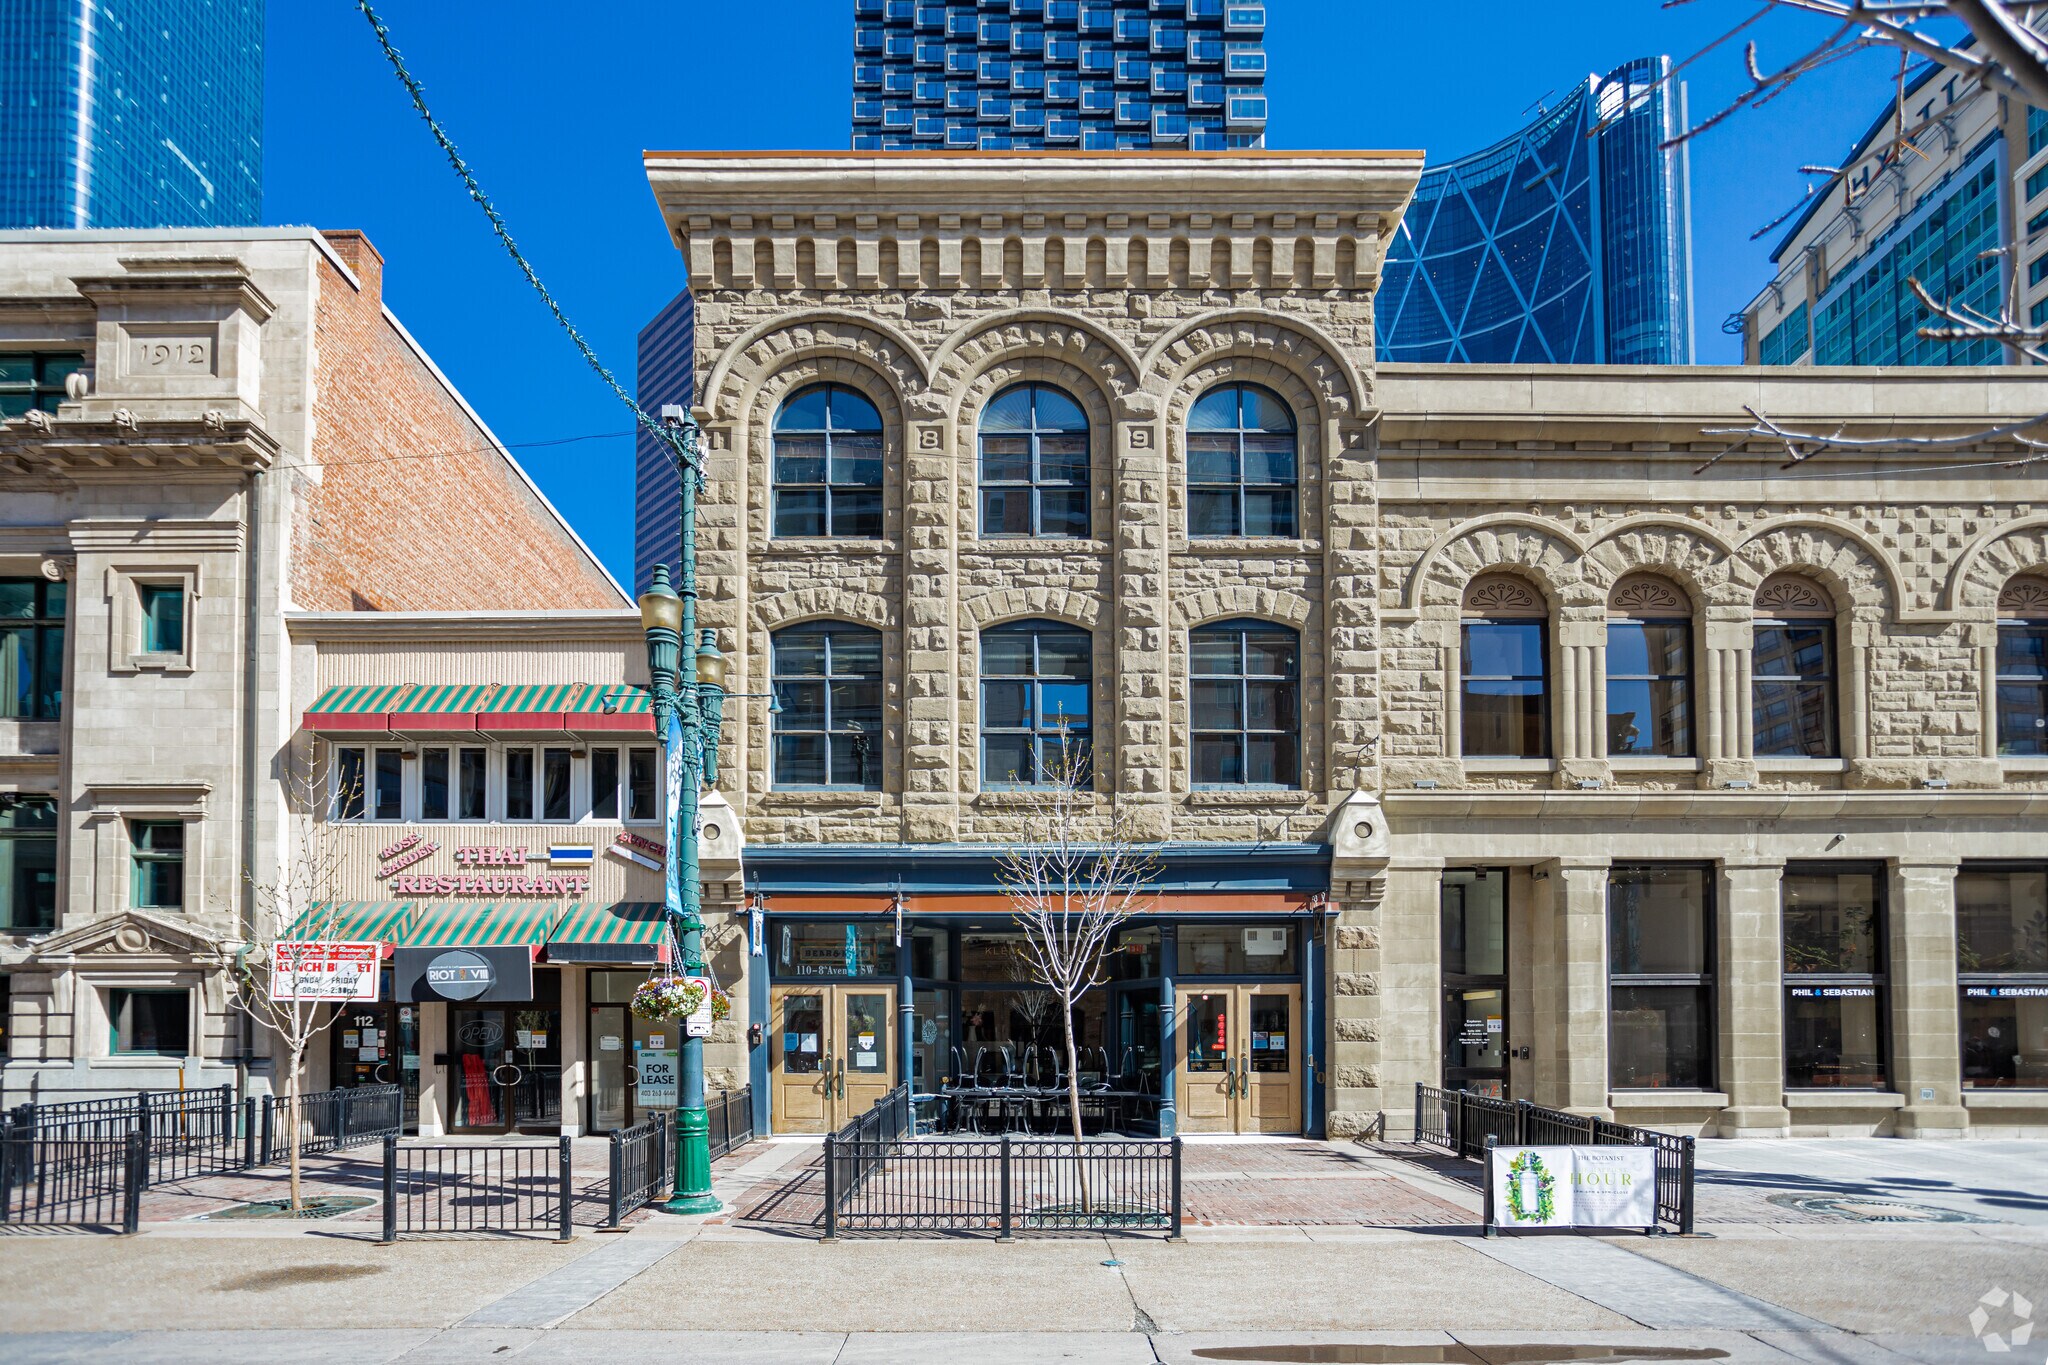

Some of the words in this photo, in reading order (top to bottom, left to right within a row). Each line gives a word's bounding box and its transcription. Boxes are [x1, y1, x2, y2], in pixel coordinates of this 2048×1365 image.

[140, 344, 204, 366] 1912
[922, 430, 938, 447] 8
[1132, 430, 1148, 447] 9
[382, 834, 420, 859] ROSE
[618, 831, 667, 858] LUNCH
[380, 842, 437, 877] GARDEN
[457, 846, 528, 866] THAI
[398, 875, 589, 894] RESTAURANT
[326, 962, 373, 973] BET
[827, 966, 858, 975] Aven
[860, 965, 875, 975] SW
[429, 970, 456, 981] RIOT
[470, 969, 489, 980] VIII
[1792, 988, 1814, 996] PHIL
[1814, 988, 1822, 996] &
[1823, 988, 1875, 996] SEBASTIAN
[1967, 988, 1990, 996] PHIL
[1990, 988, 1998, 996] &
[353, 1016, 374, 1027] 112
[401, 1021, 420, 1031] OPE
[461, 1027, 499, 1040] OPEN
[646, 1064, 669, 1074] FOR
[641, 1075, 675, 1085] LEASE
[1570, 1172, 1632, 1186] HOUR
